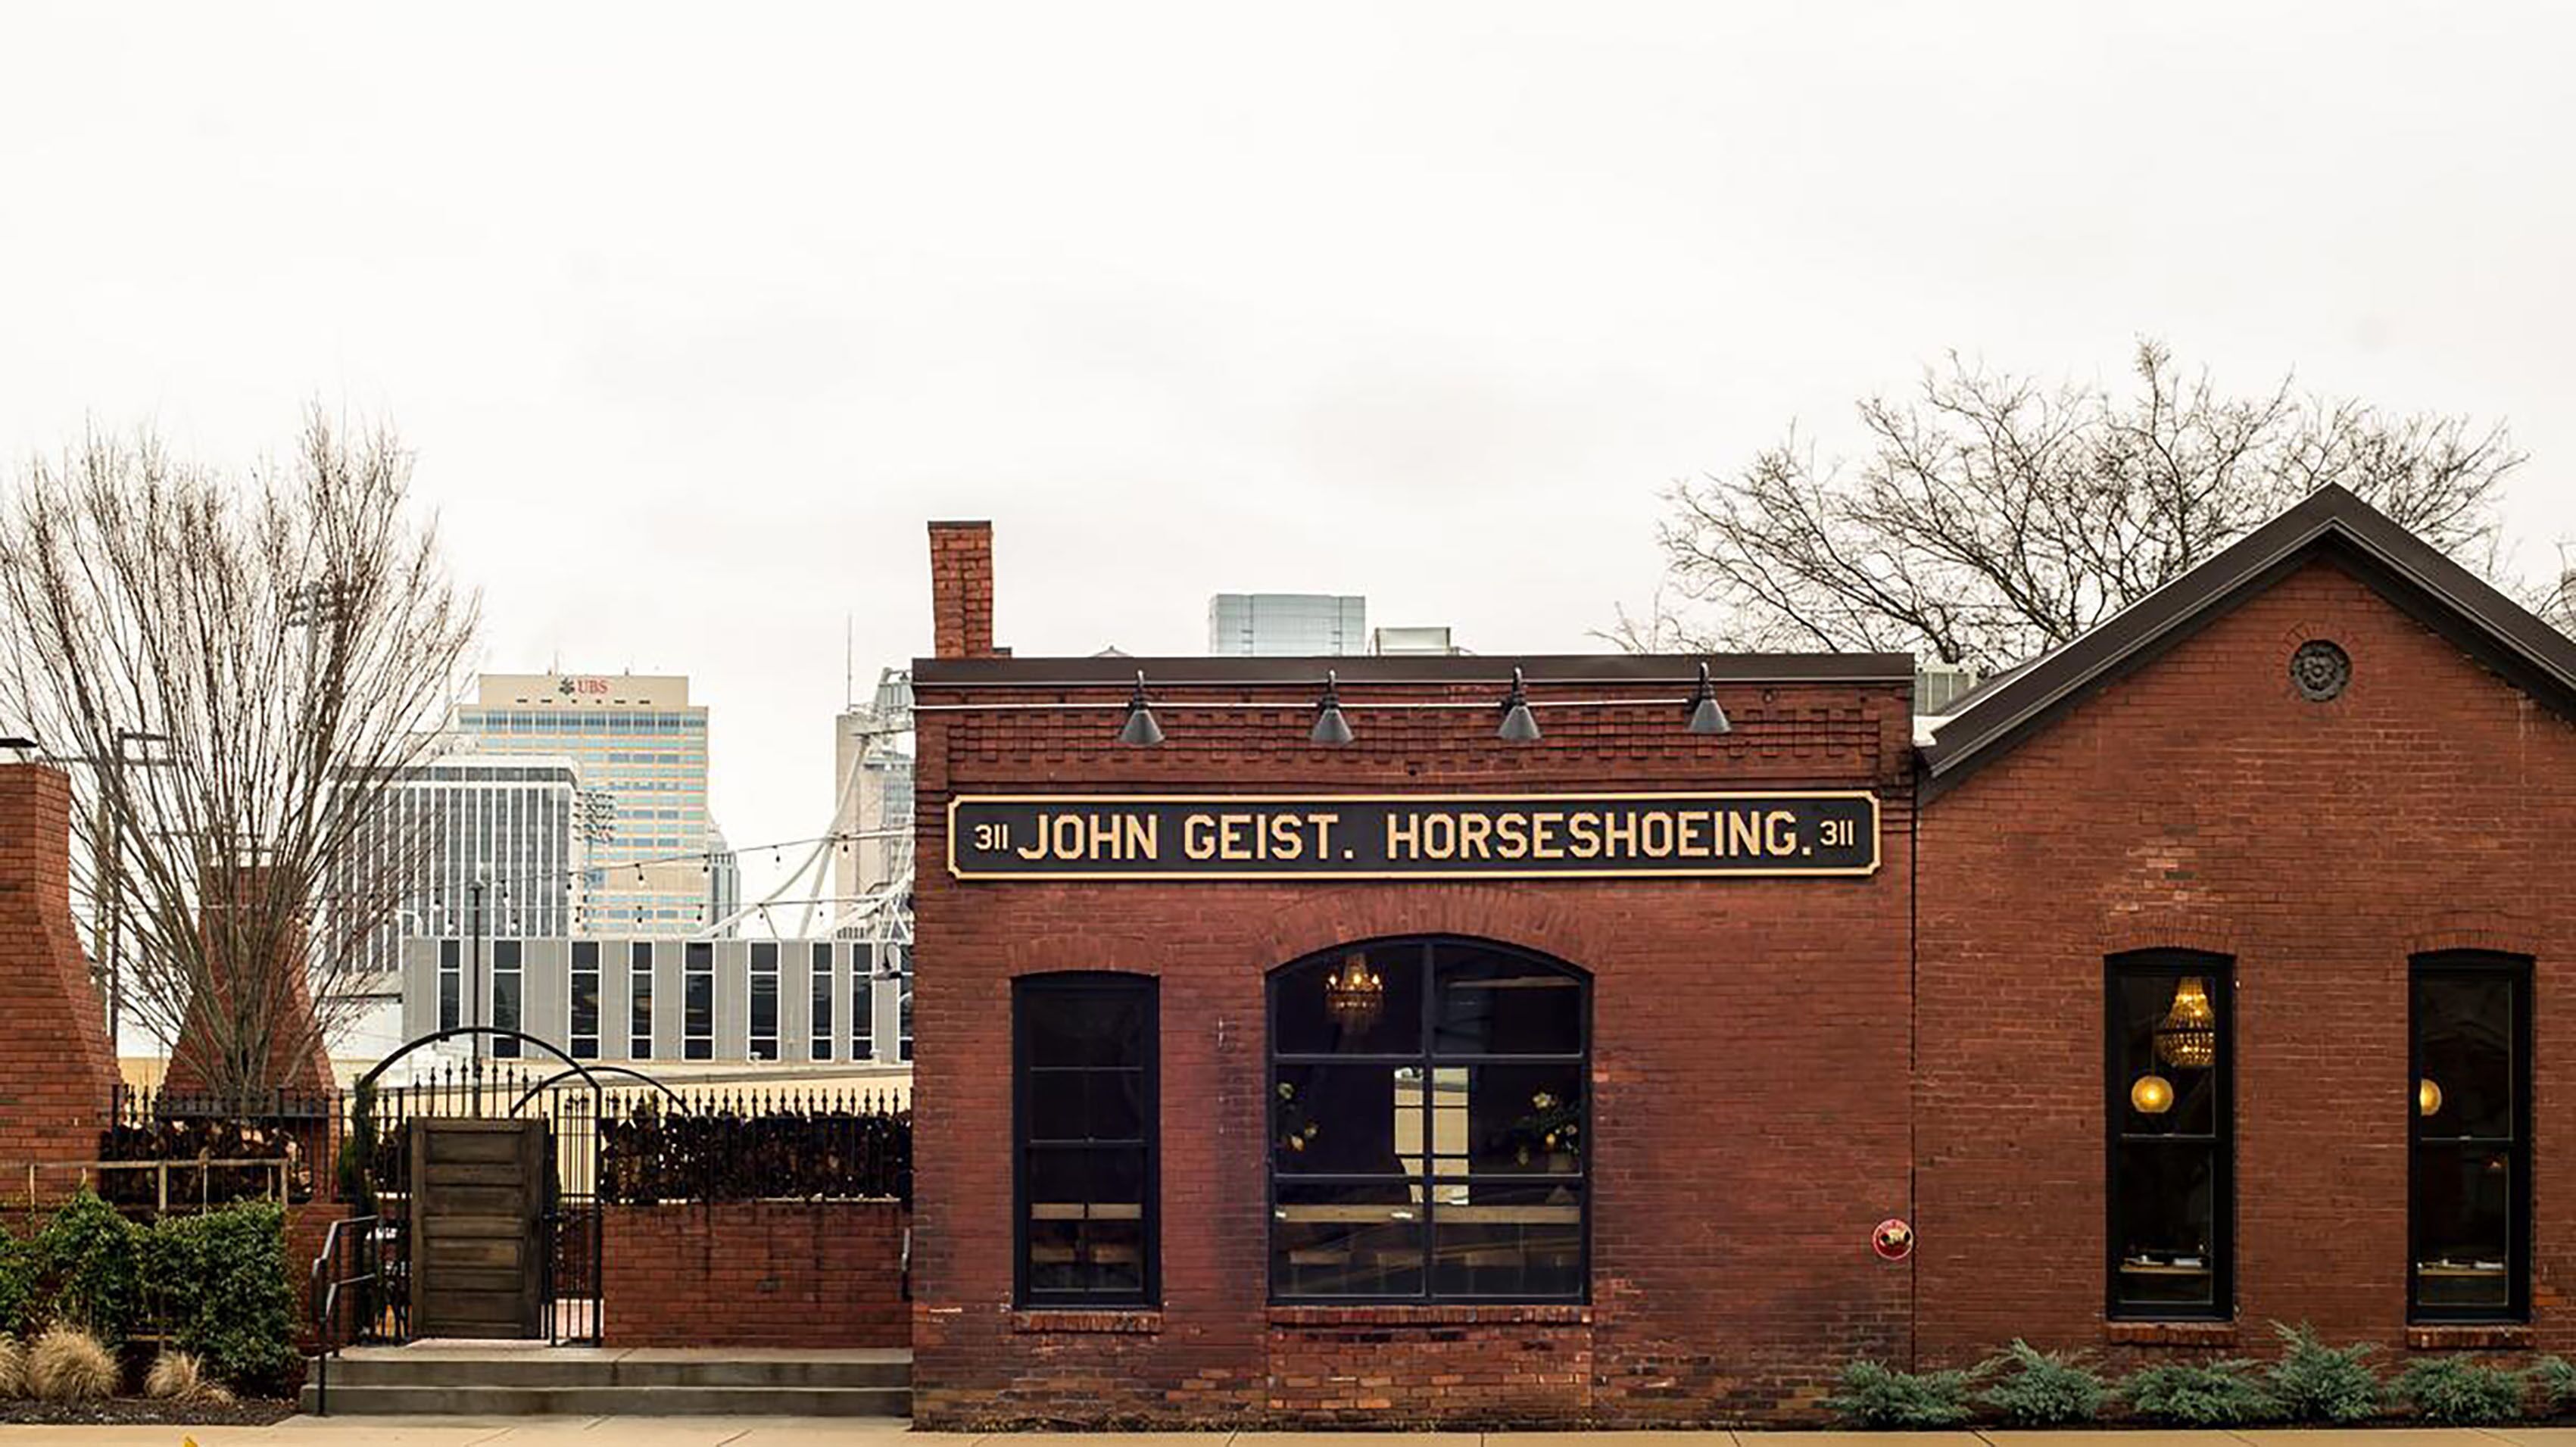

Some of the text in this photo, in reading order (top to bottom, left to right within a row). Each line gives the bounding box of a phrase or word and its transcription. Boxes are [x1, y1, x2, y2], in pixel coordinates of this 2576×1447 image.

[578, 680, 608, 694] UBS
[975, 810, 1854, 859] 311 JOHN GEIST. HORSESHOEING. 311
